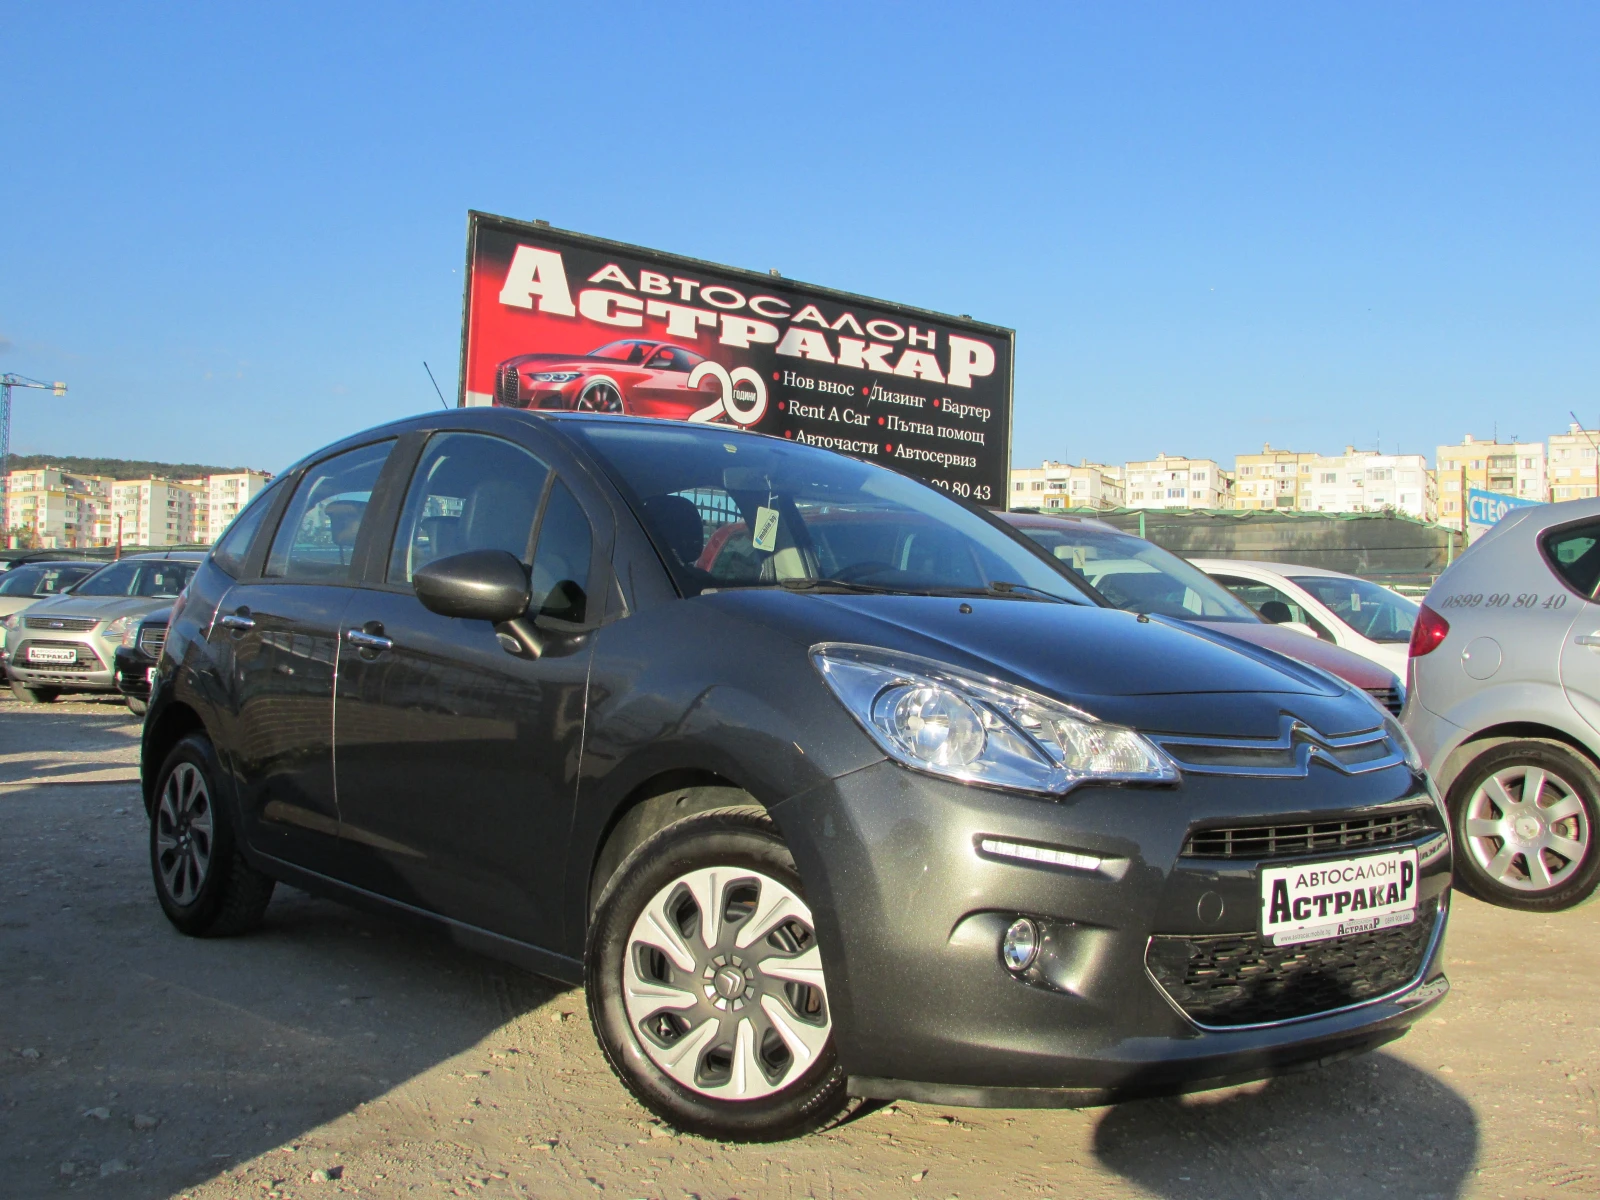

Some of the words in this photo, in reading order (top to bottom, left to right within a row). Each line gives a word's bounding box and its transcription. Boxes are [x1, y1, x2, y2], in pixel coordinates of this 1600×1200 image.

[498, 244, 995, 388] АСТРАКАР
[588, 264, 936, 350] АВТОСАЛОН
[687, 361, 768, 424] 20
[732, 389, 757, 402] ГОДИНИ
[783, 371, 815, 390] Нов
[818, 381, 855, 396] внос
[871, 386, 927, 408] Лизинг
[941, 398, 991, 422] Бартер
[788, 400, 826, 420] Rent
[828, 407, 840, 421] A
[842, 409, 871, 426] Car
[887, 416, 935, 436] Пътна
[937, 426, 985, 446] помощ
[795, 430, 879, 455] Авточасти
[894, 444, 977, 468] Автосервиз
[952, 482, 971, 498] 80
[973, 486, 991, 500] 43
[1440, 594, 1484, 609] 0899
[1484, 593, 1510, 608] 90
[1512, 593, 1538, 609] 80
[1541, 594, 1567, 610] 40
[1295, 860, 1397, 889] АВТОСАЛОН
[1269, 860, 1414, 924] АСТРАКАР
